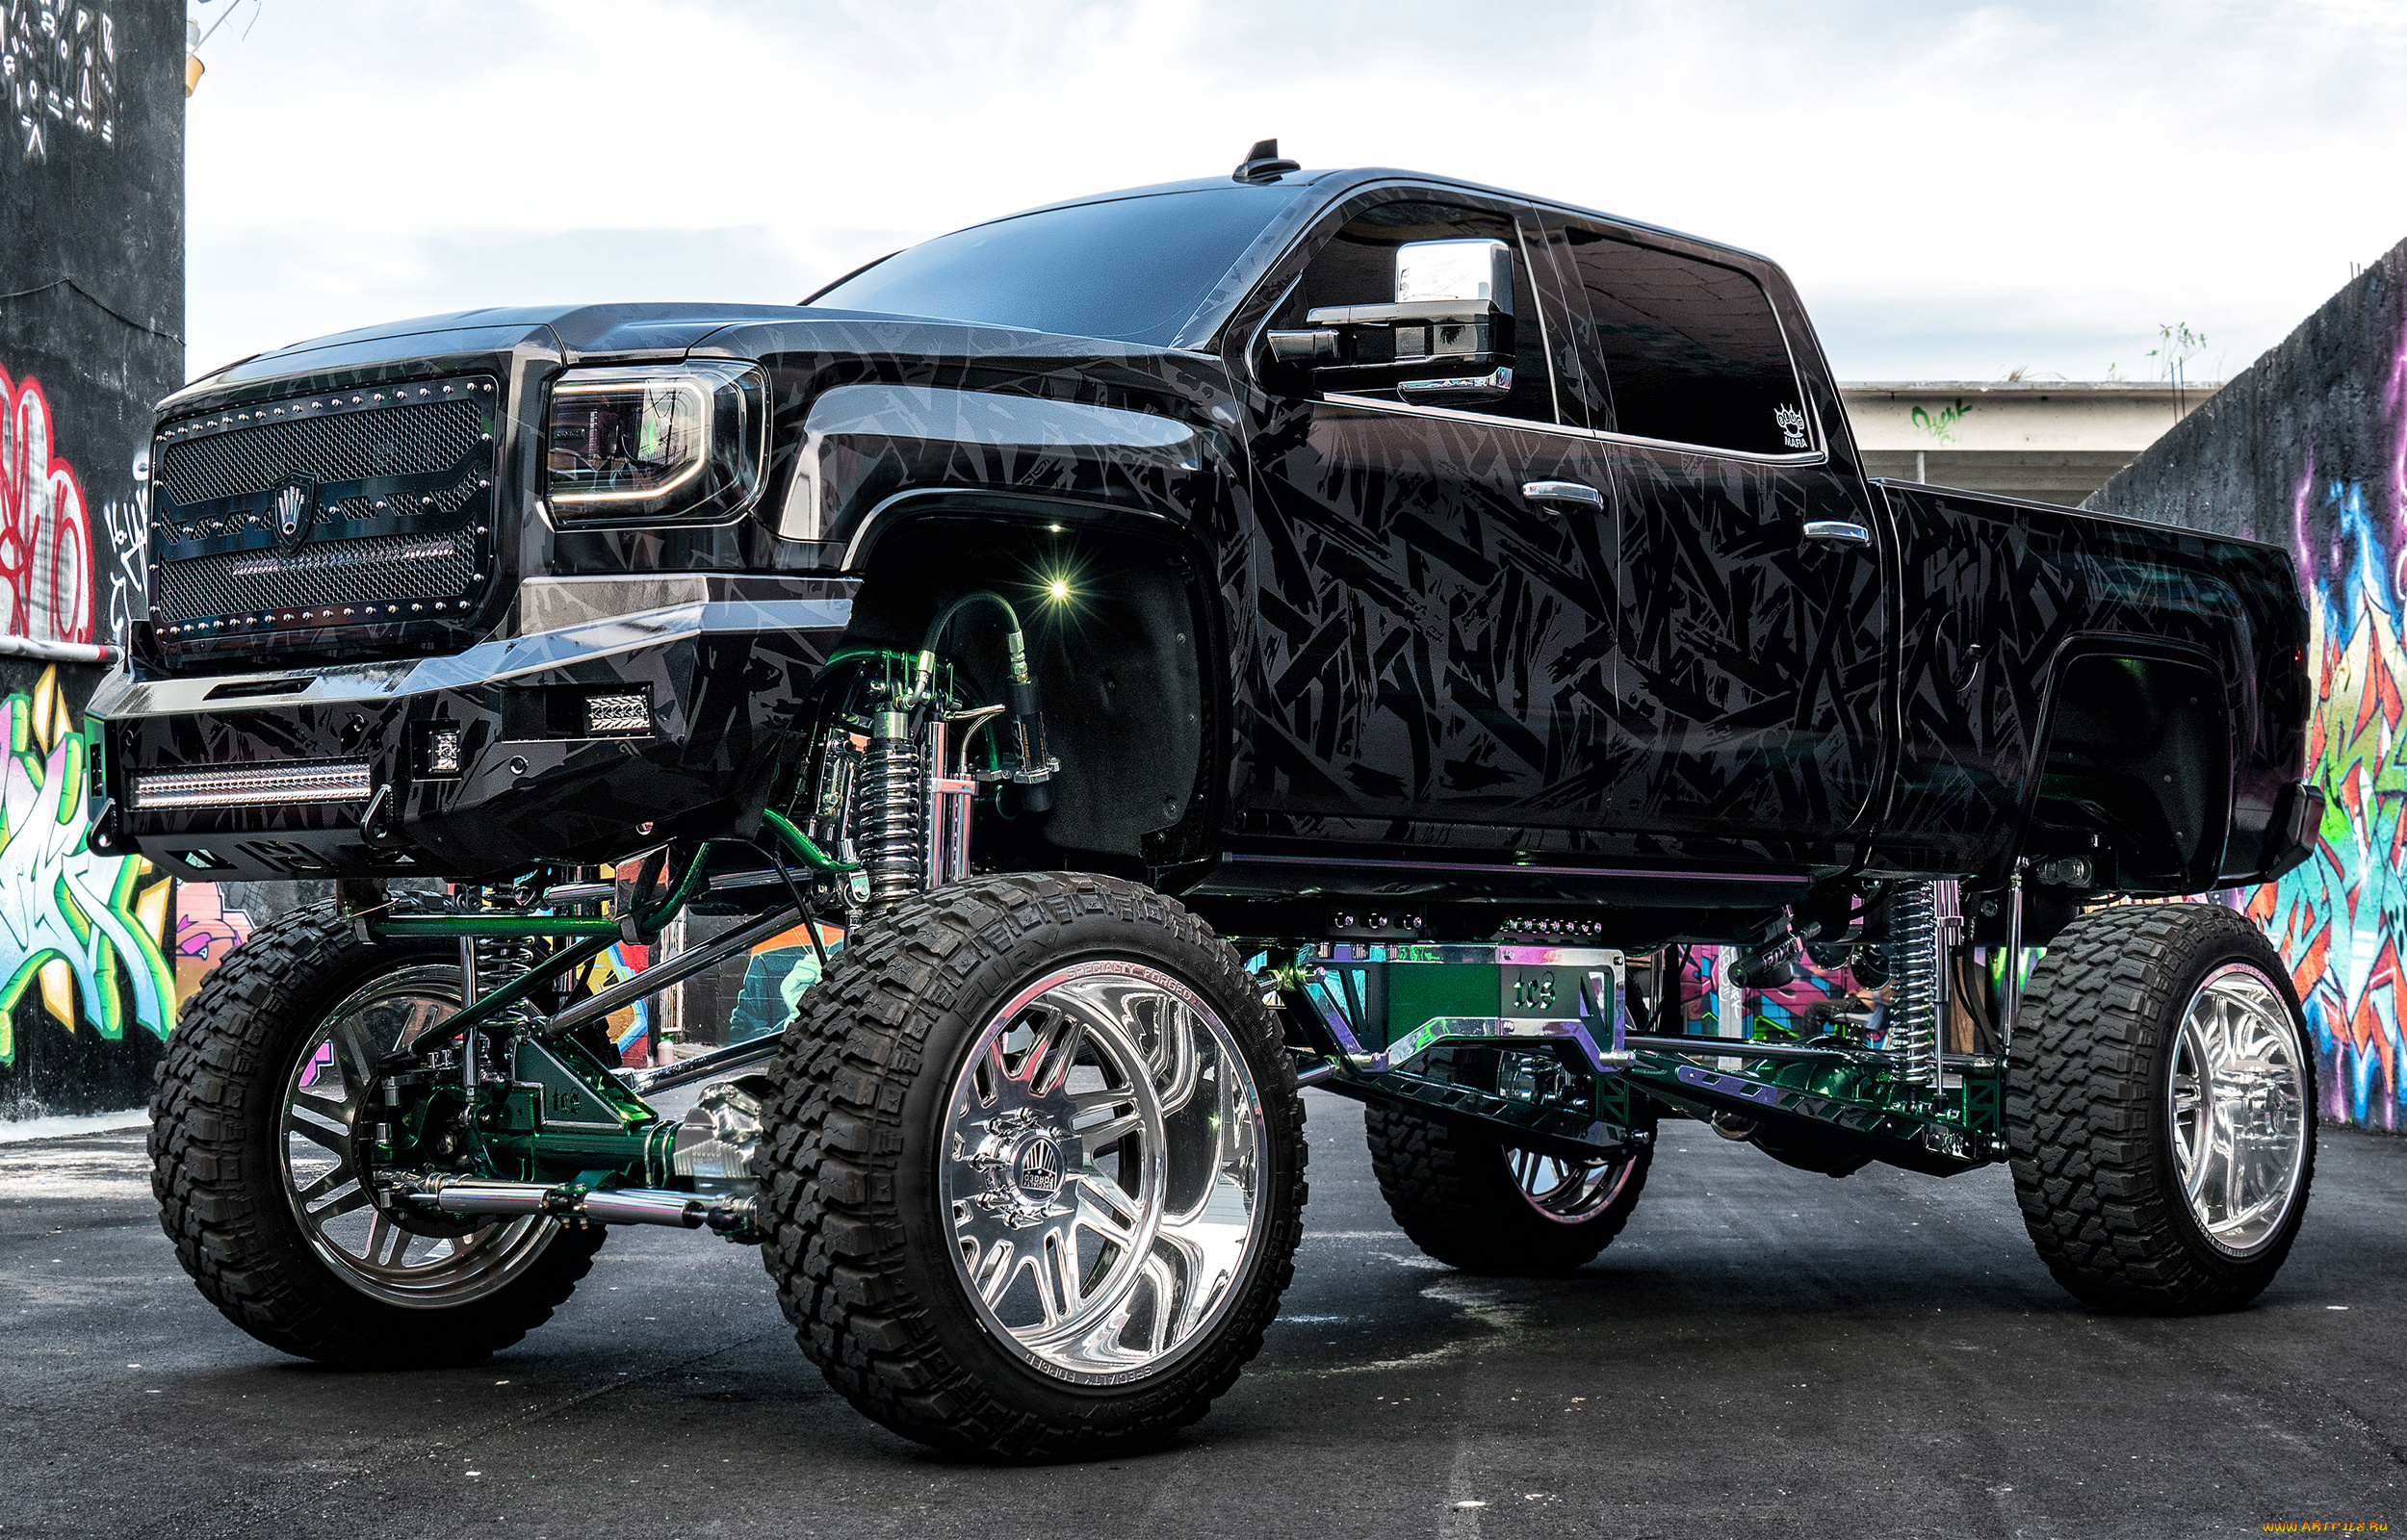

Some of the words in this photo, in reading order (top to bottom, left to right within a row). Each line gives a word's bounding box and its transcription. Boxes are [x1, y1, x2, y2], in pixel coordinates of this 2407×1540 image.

[1784, 436, 1808, 449] MAFIA
[1762, 939, 1794, 973] FOX
[953, 928, 1061, 1027] FURY
[1066, 962, 1135, 980] SPECIALTY
[1143, 967, 1193, 1000] FORGED
[1023, 1174, 1054, 1185] FORGED
[1025, 1353, 1075, 1383] FORGED
[1084, 1365, 1153, 1386] SPECIALTY
